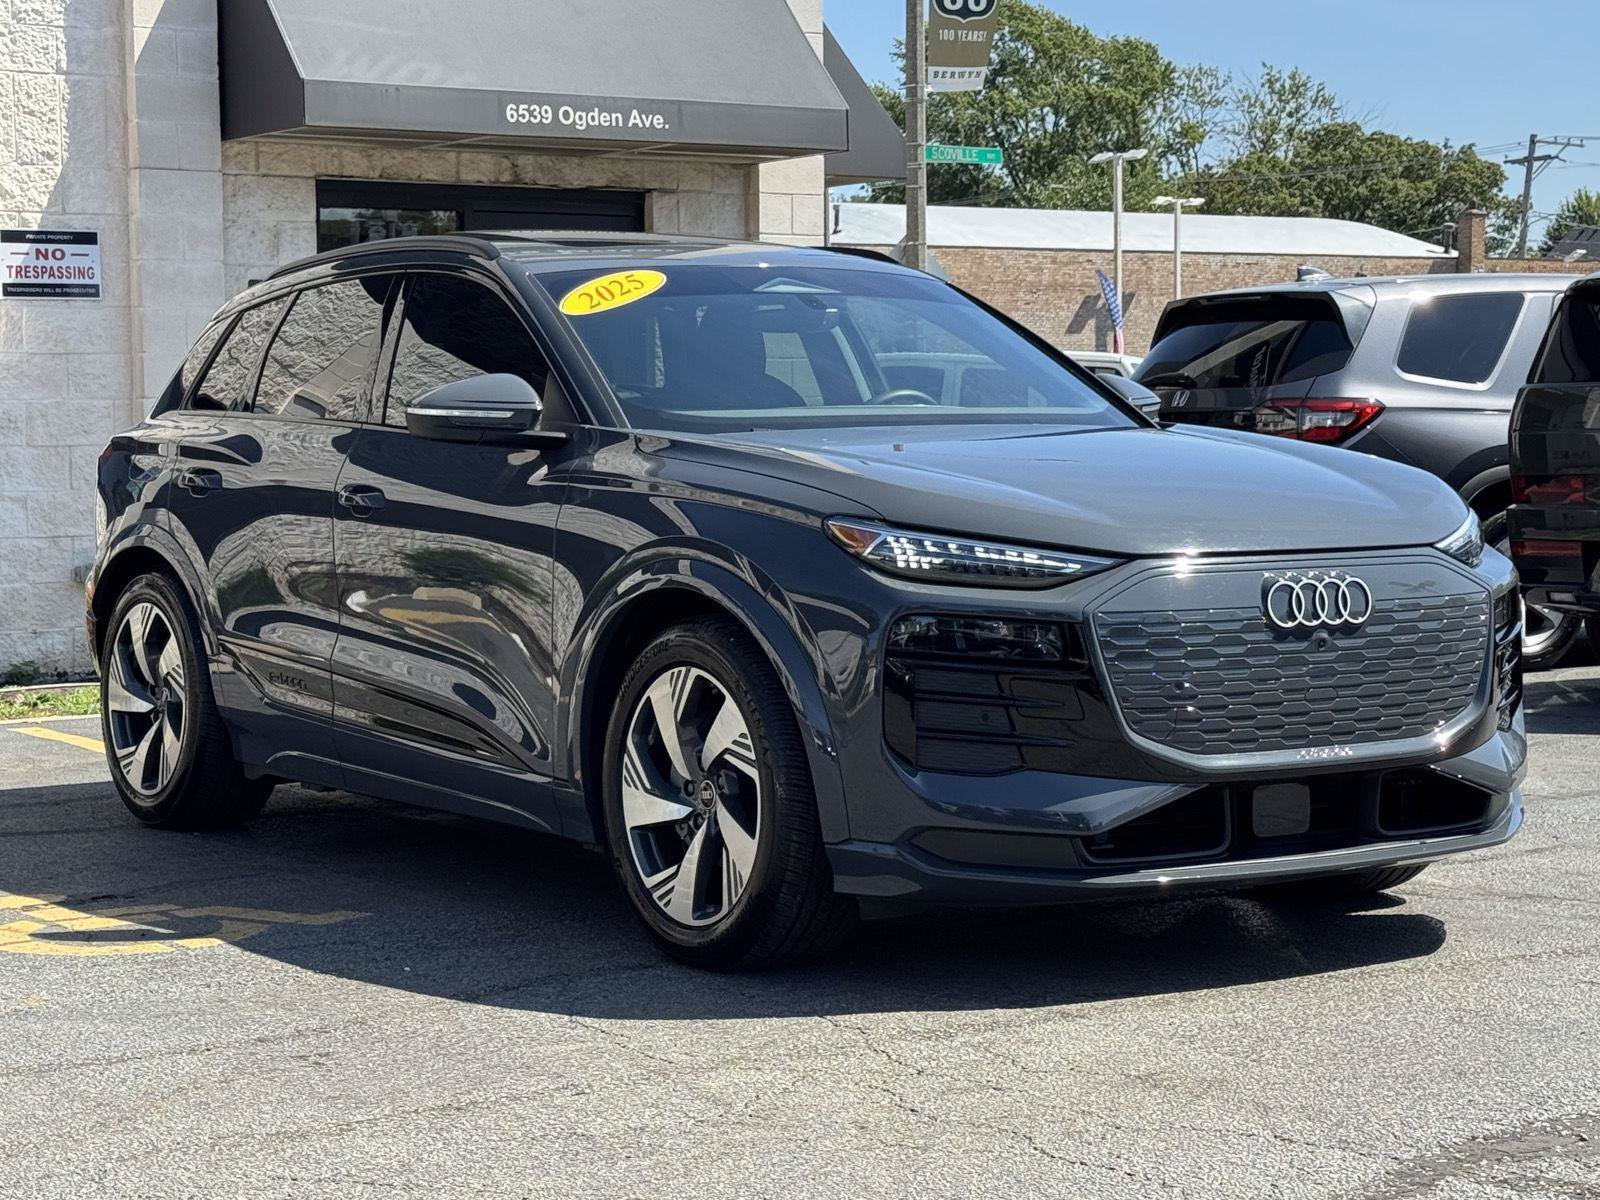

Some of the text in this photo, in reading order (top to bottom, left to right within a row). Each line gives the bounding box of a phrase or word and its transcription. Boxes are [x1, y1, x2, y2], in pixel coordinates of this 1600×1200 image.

[938, 28, 987, 42] 100 YEARS!
[932, 70, 982, 79] BERWYN
[505, 103, 670, 131] 6539 Ogden Ave.
[931, 147, 979, 161] SCOVILLE
[34, 248, 66, 261] NO
[6, 265, 95, 280] TRESPASSING
[578, 273, 645, 310] 2025
